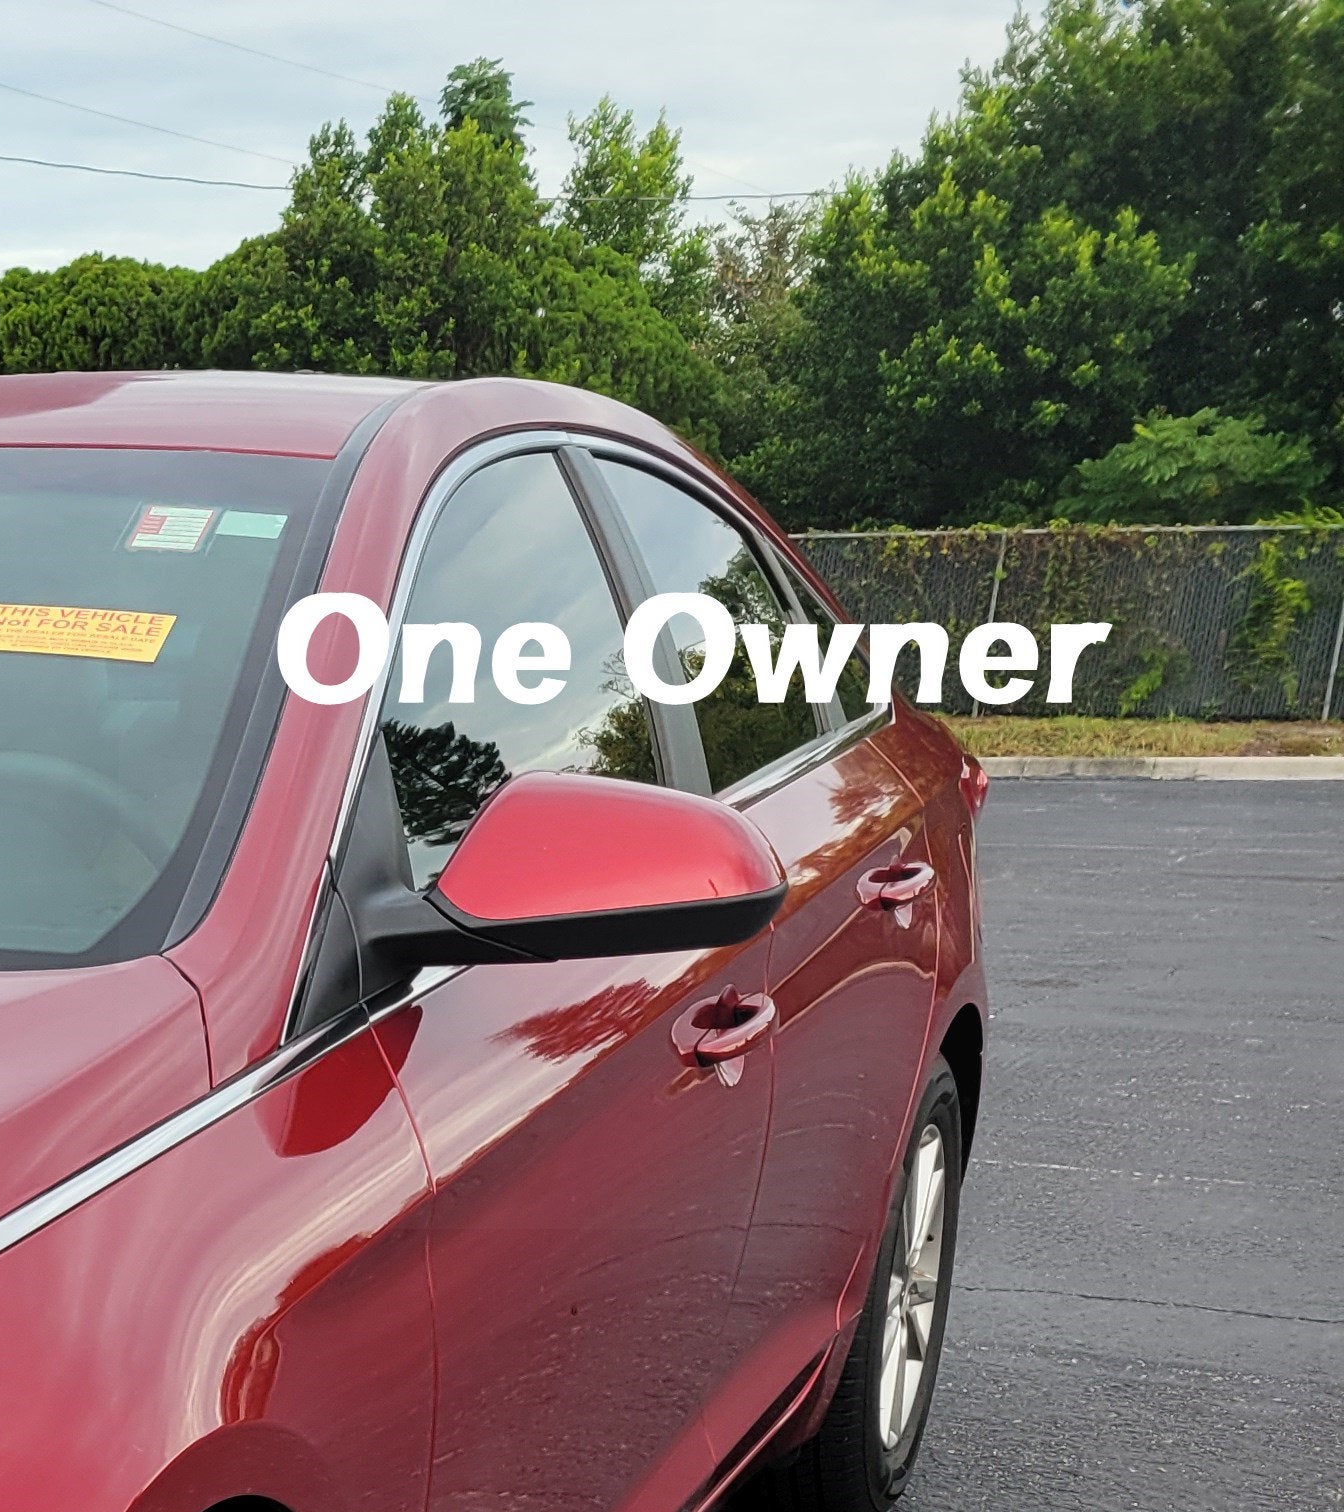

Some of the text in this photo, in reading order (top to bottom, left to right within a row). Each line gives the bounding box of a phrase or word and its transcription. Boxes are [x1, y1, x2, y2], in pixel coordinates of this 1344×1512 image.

[59, 607, 164, 626] VEHICLE
[37, 619, 89, 632] FOR
[94, 622, 164, 637] SALE
